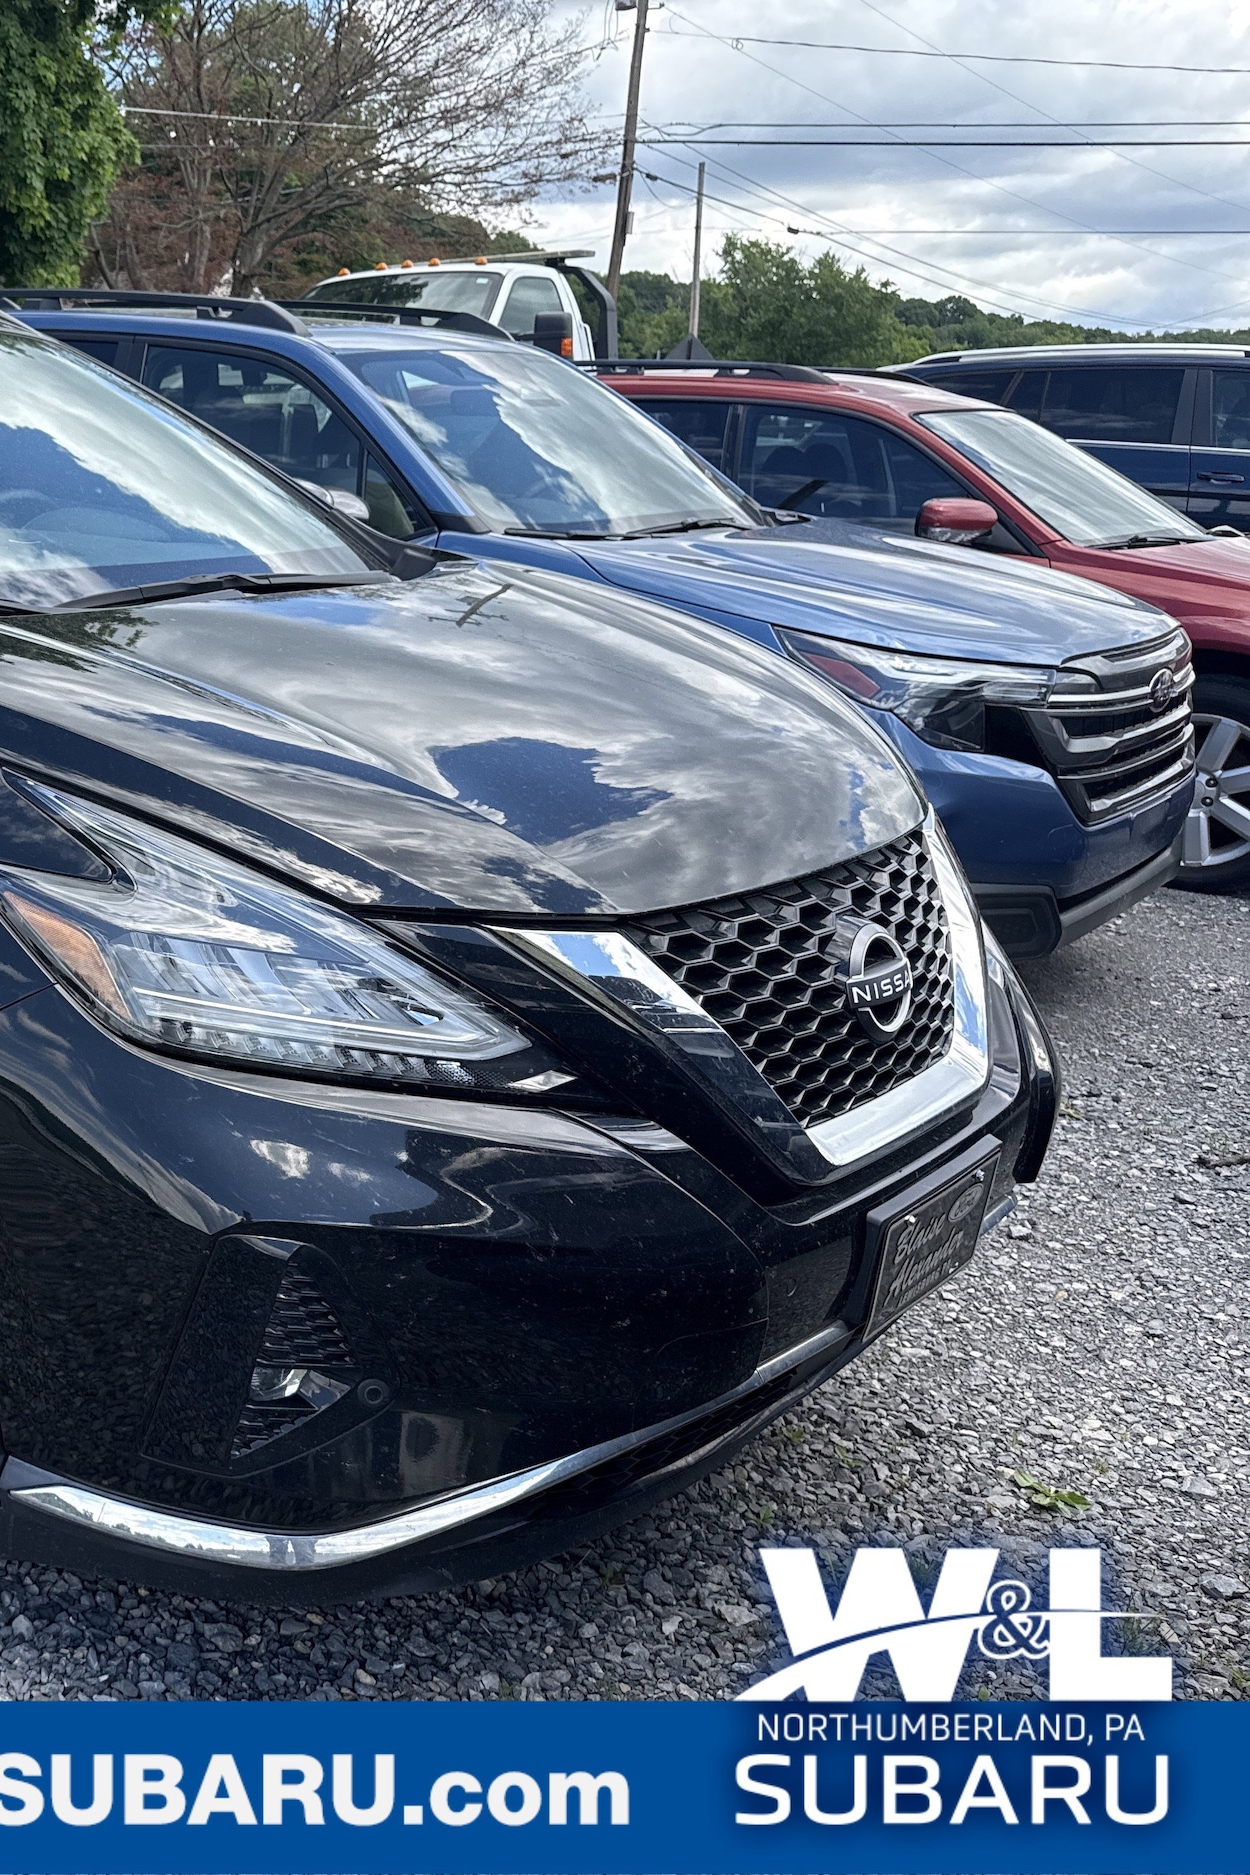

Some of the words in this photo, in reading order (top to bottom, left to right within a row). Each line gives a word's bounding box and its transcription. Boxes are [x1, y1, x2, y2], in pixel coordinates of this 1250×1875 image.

[851, 969, 913, 1004] NISSA
[894, 1213, 947, 1265] Blaise
[882, 1226, 964, 1308] Alexander
